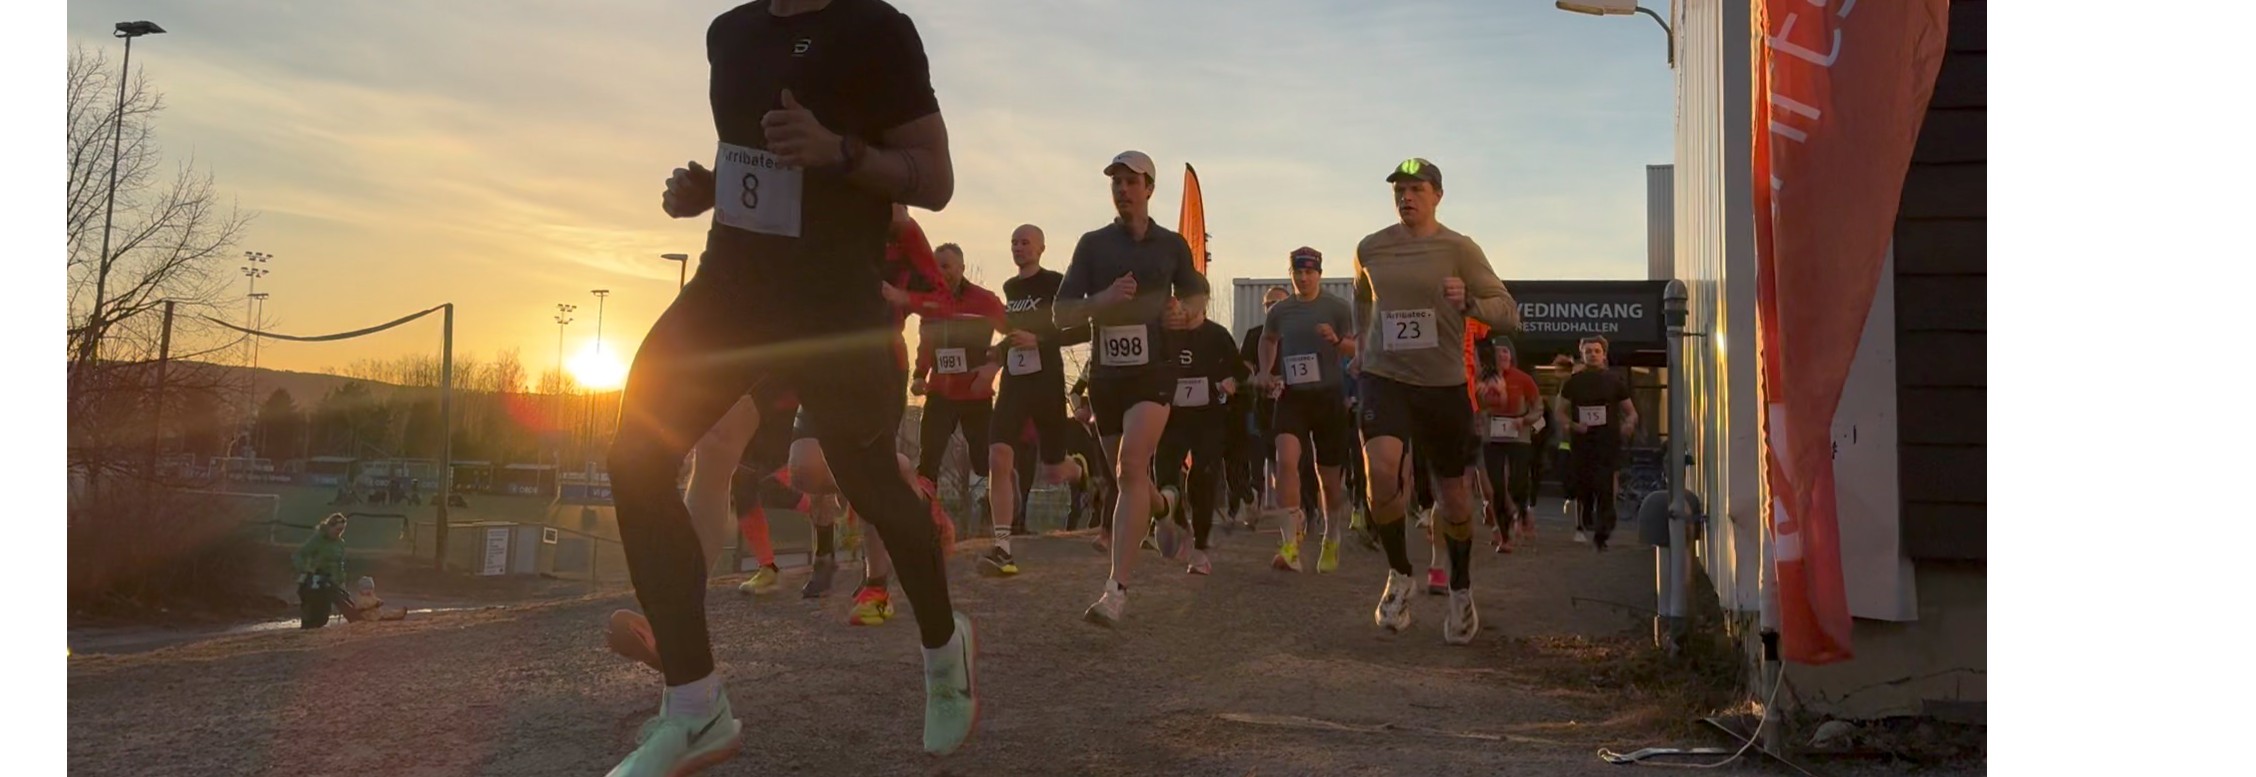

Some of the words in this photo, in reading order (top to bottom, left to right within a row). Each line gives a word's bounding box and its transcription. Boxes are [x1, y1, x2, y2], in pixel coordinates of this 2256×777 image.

[742, 172, 758, 209] 8
[1396, 321, 1420, 339] 23
[1105, 337, 1142, 357] 1998
[1018, 354, 1025, 367] 2
[1291, 363, 1308, 377] 13
[1185, 386, 1193, 399] 7
[1587, 412, 1600, 421] 15
